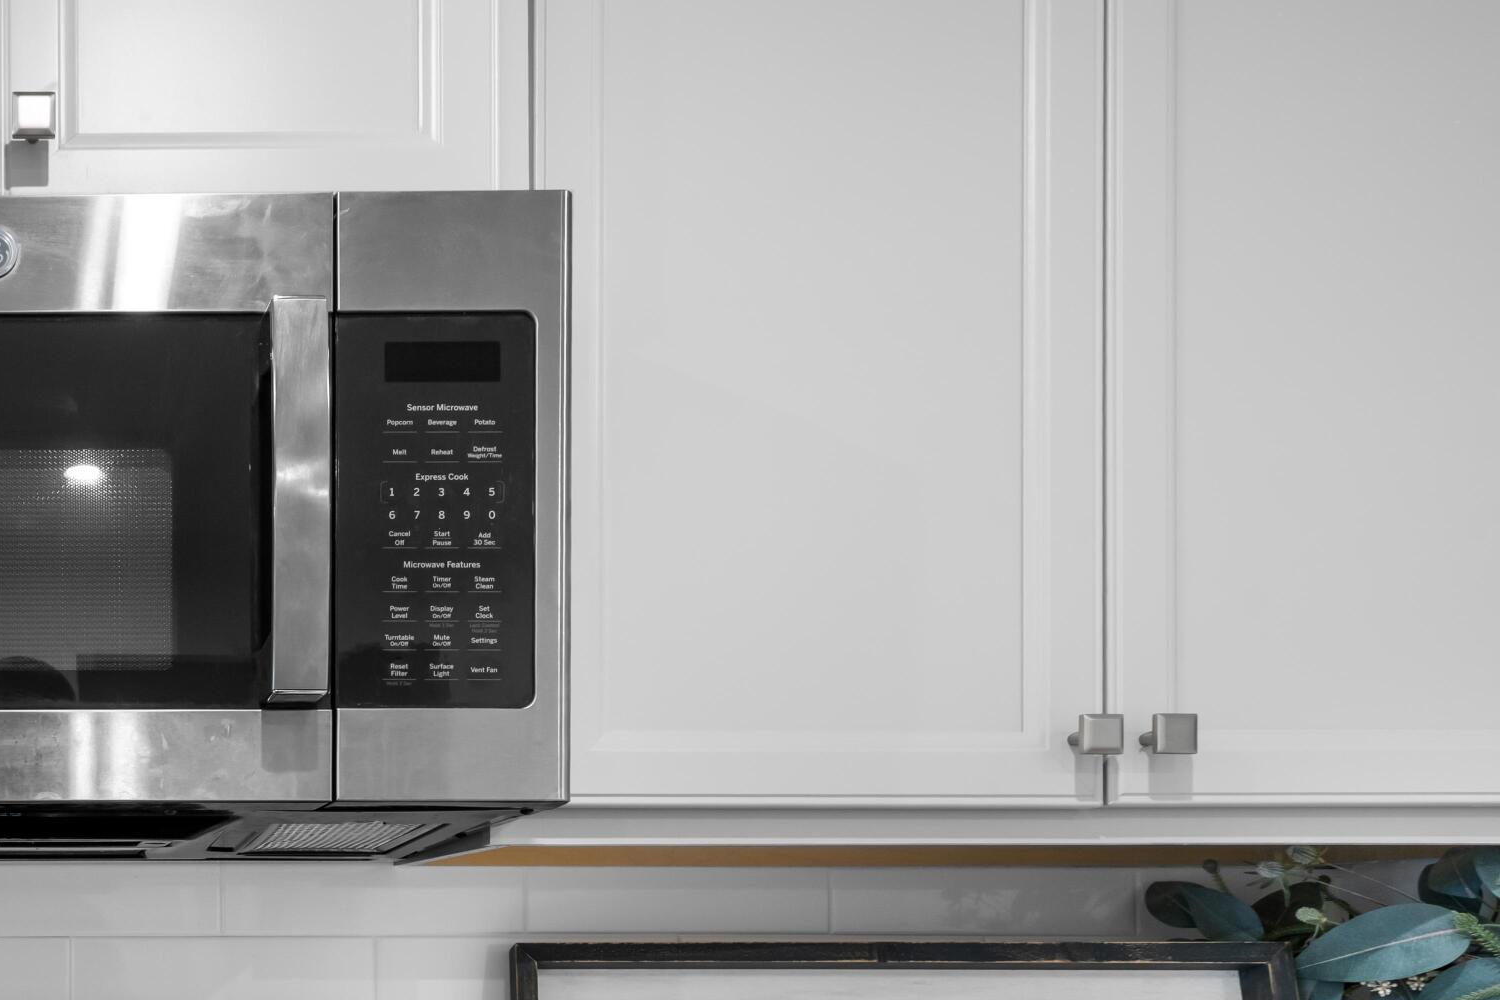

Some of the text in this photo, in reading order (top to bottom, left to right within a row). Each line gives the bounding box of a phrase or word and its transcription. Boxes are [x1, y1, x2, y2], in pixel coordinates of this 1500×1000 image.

[415, 473, 446, 481] Express
[389, 488, 495, 496] 1 2 3 4 5
[389, 511, 495, 519] 6 7 8 9 0
[404, 561, 480, 569] Microwave Features
